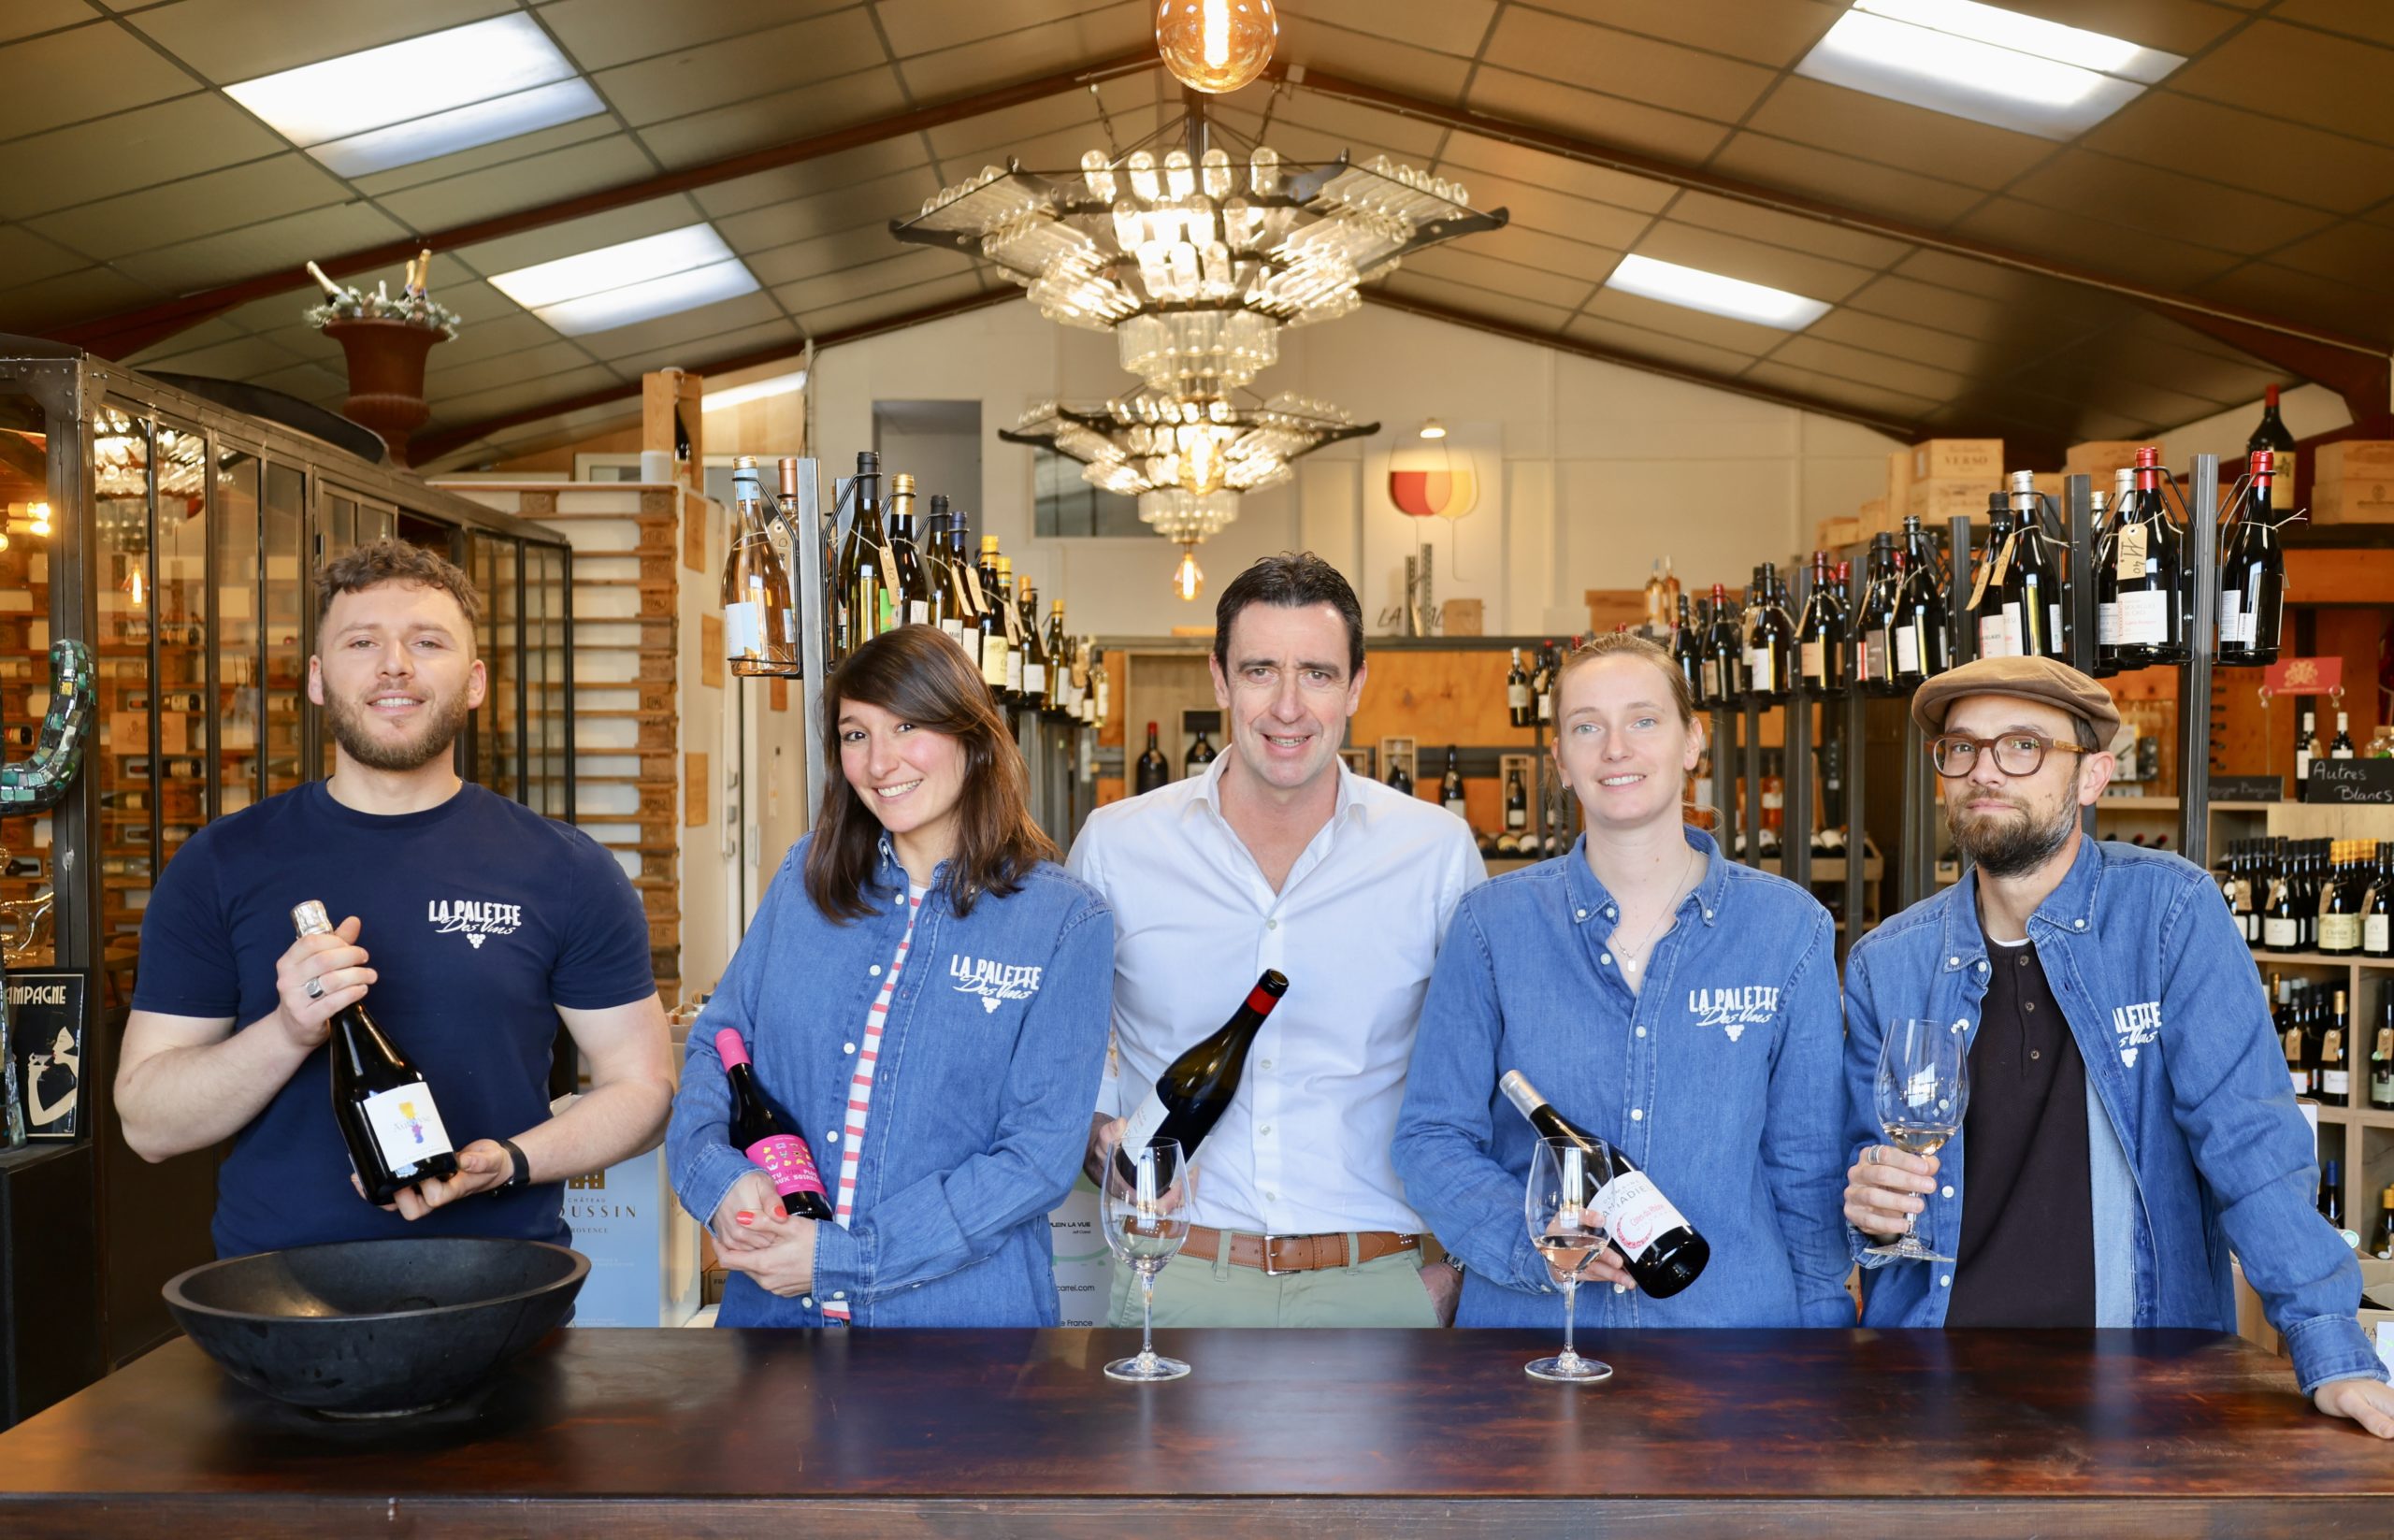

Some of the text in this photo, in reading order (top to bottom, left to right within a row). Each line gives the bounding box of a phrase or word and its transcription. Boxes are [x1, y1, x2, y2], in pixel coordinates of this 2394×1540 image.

[1945, 455, 1989, 465] VERSO
[2313, 760, 2368, 782] Autres
[2334, 784, 2394, 803] Blancs
[428, 900, 523, 927] LA PALETTE
[434, 915, 480, 933] Des
[950, 954, 1043, 991] LA PALETTE
[6, 985, 67, 1005] AMPAGNE
[952, 974, 998, 997] Des
[1689, 986, 1781, 1013] LA PALETTE
[1695, 1006, 1739, 1027] Des
[2112, 1001, 2162, 1034] LETTE
[1057, 1284, 1095, 1292] carrel.com
[1067, 1318, 1093, 1327] France
